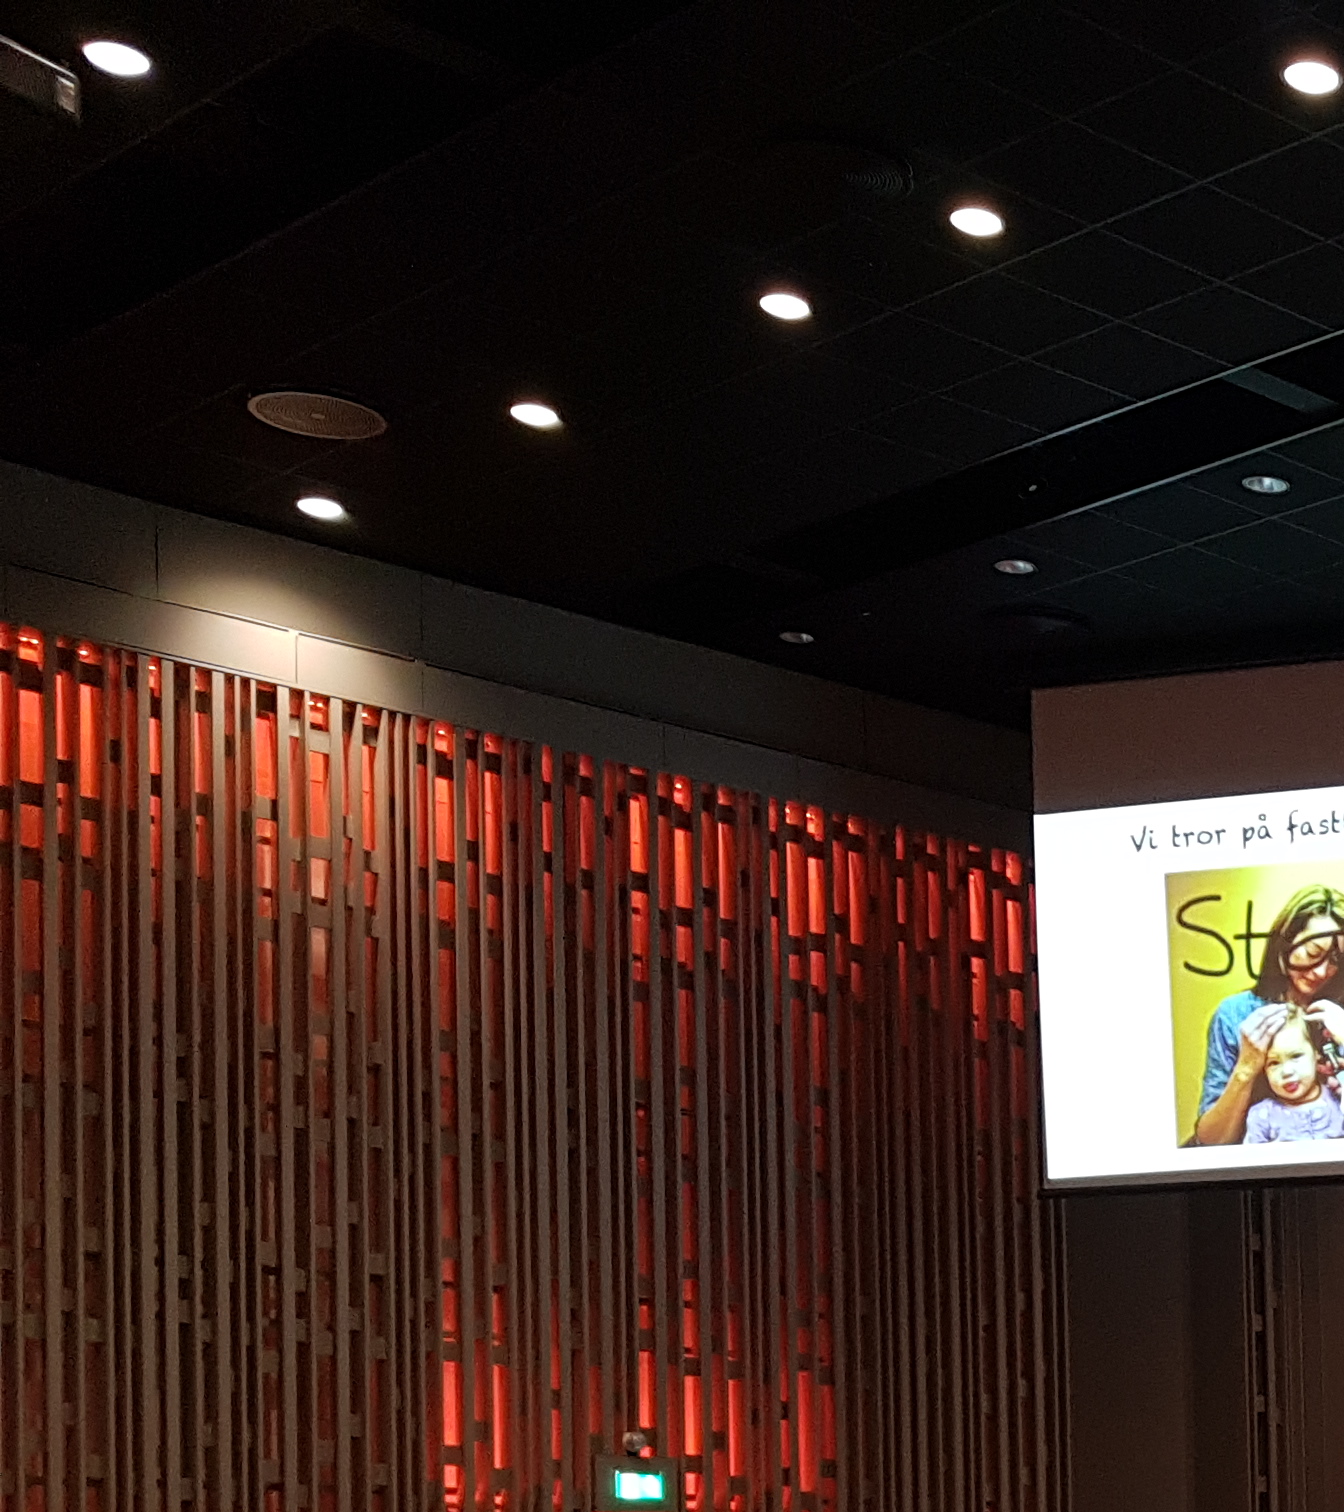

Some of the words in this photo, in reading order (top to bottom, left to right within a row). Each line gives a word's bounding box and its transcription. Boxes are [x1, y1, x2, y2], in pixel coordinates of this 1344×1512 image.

[1130, 825, 1158, 853] Vi
[1171, 824, 1227, 848] tror
[1242, 813, 1273, 853] på
